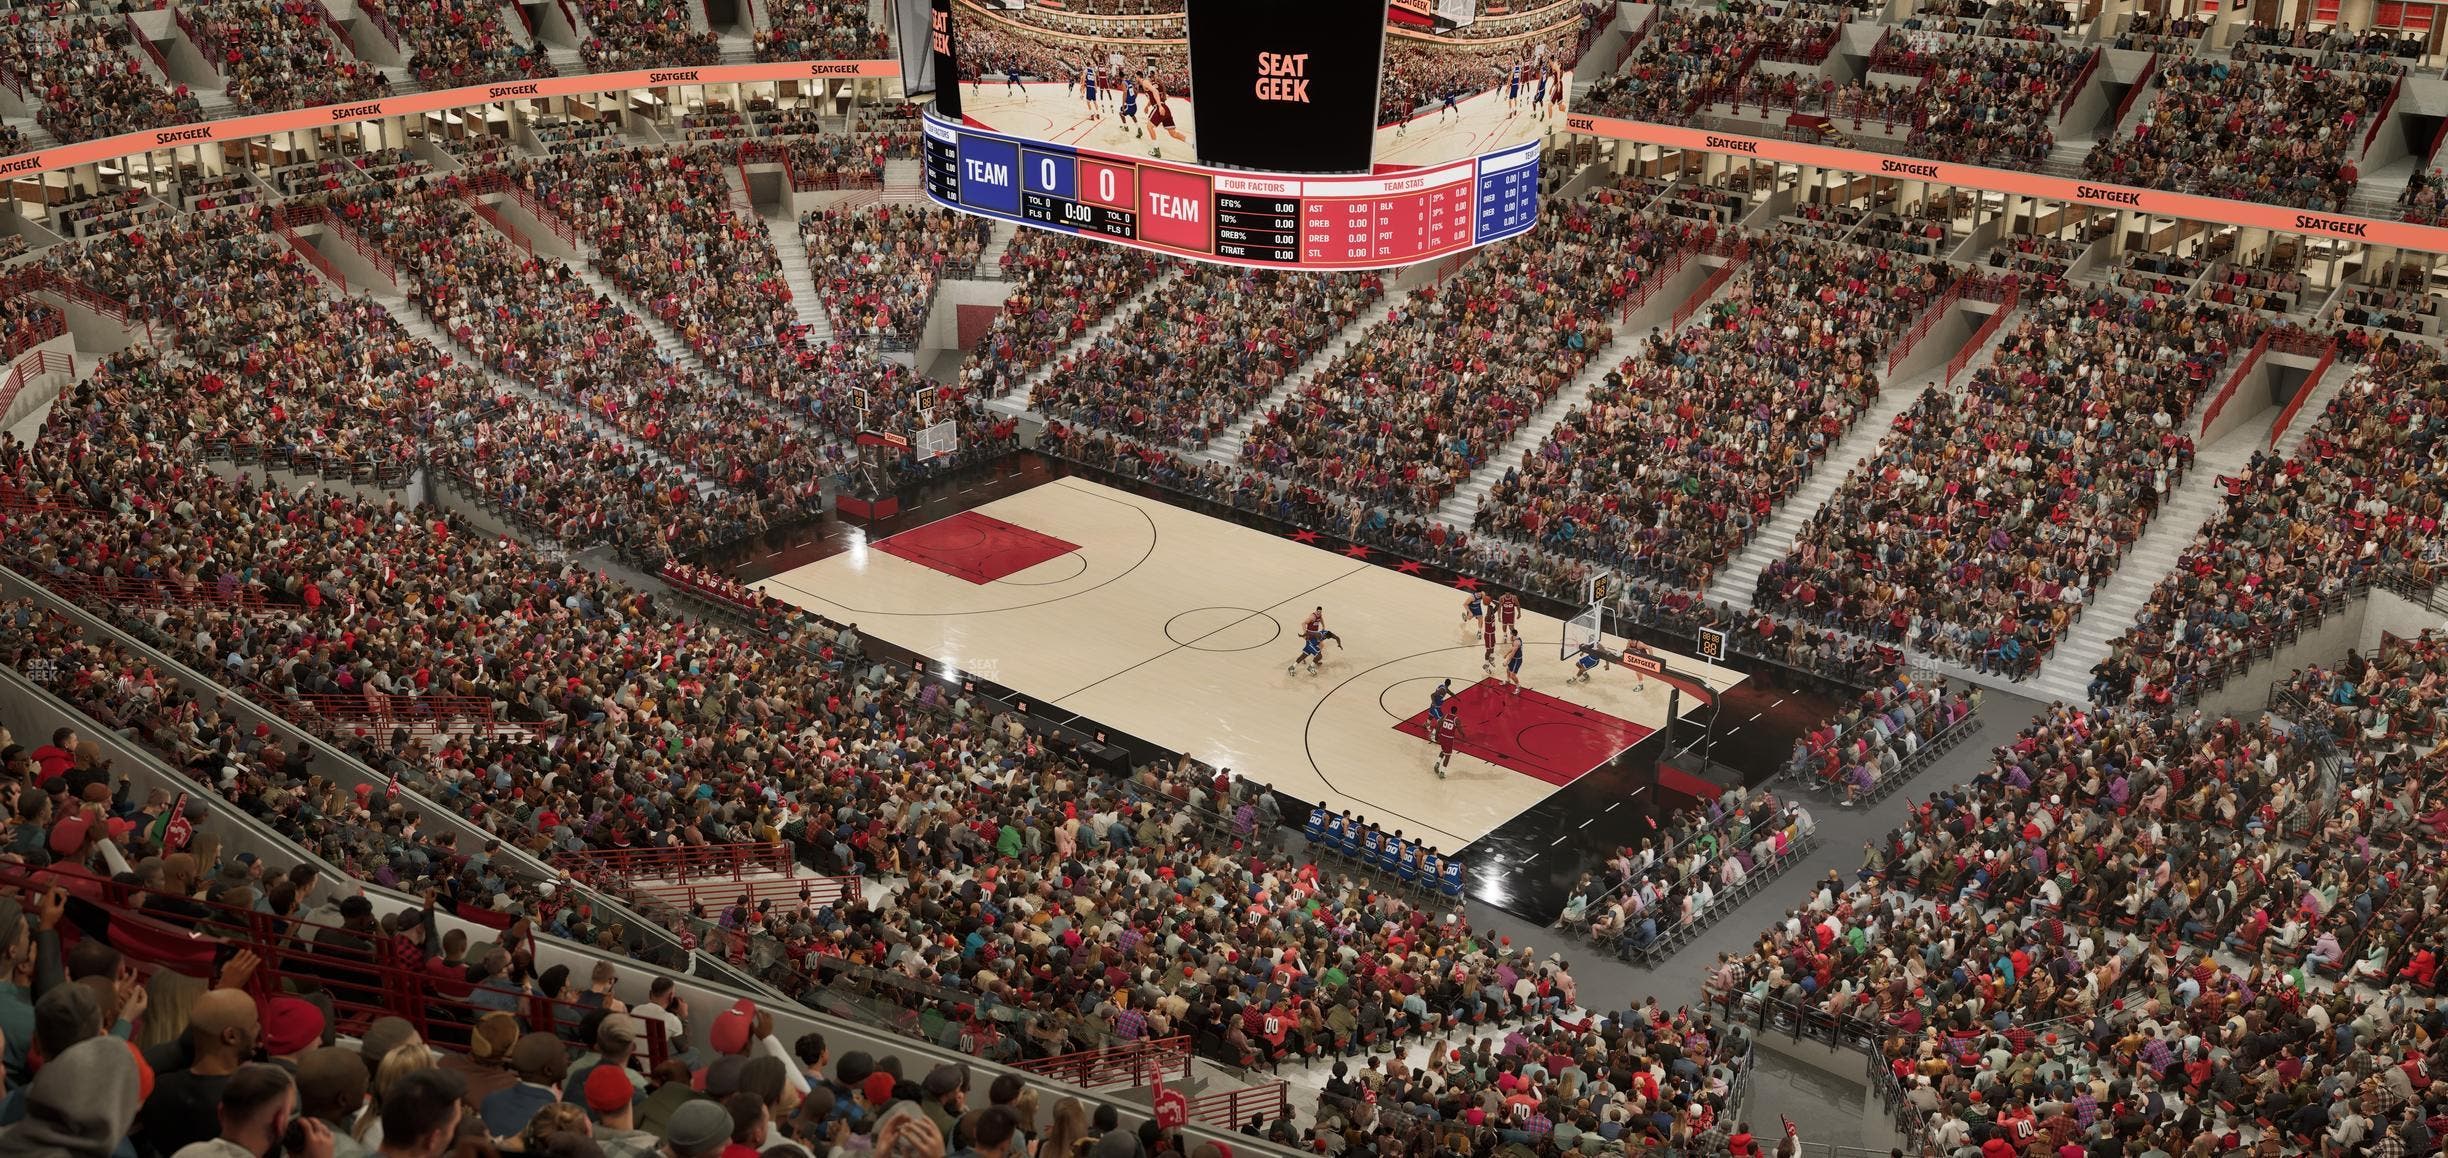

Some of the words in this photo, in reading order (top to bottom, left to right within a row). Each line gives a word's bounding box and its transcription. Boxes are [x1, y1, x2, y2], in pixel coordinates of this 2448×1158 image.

[811, 63, 860, 75] SEATGEEK
[1258, 51, 1309, 77] SEAT
[650, 70, 699, 83] SEATGEEK
[489, 83, 538, 98] SEATGEEK
[1255, 77, 1310, 103] GEEK
[332, 103, 382, 120] SEATGEEK
[156, 126, 212, 145] SEATGEEK
[1706, 136, 1757, 153] SEATGEEK
[0, 156, 42, 174] ATGEEK
[1882, 159, 1938, 178] SEATGEEK
[965, 158, 1008, 187] TEAM
[1041, 158, 1056, 191] 0
[1099, 168, 1115, 202] 0
[1224, 179, 1246, 190] FOUR
[1248, 182, 1285, 193] FACTORS
[1383, 181, 1404, 191] TEAM
[1405, 178, 1424, 189] STATS
[1484, 180, 1492, 189] AST
[1028, 196, 1043, 206] TOL
[1045, 198, 1050, 207] 0
[2077, 185, 2140, 206] SEATGEEK
[1065, 203, 1091, 222] 0:00
[1149, 192, 1199, 223] TEAM
[1220, 199, 1242, 209] EFG%
[1275, 203, 1294, 212] 0.00
[1308, 204, 1323, 213] AST
[1349, 204, 1367, 213] 0.00
[1380, 202, 1394, 211] BLK
[1029, 209, 1042, 218] FLS
[1046, 211, 1051, 221] 0
[1106, 211, 1122, 221] TOL
[1124, 213, 1130, 223] 0
[1107, 224, 1121, 233] FLS
[1125, 227, 1130, 236] 0
[1275, 219, 1294, 228] 0.00
[1349, 219, 1367, 228] 0.00
[2296, 215, 2367, 237] SEATGEEK
[1220, 230, 1246, 240] OREB%
[1275, 235, 1294, 244] 0.00
[1308, 234, 1330, 242] DREB
[1348, 234, 1367, 243] 0.00
[1379, 232, 1393, 240] POT
[1220, 245, 1245, 256] FTRATE
[1274, 250, 1294, 260] 0.00
[1308, 249, 1322, 257] STL
[1348, 248, 1367, 258] 0.00
[1379, 247, 1391, 255] STL
[1703, 641, 1717, 656] 88
[1627, 655, 1657, 670] SEATGEEK
[1443, 721, 1453, 730] 00
[1309, 816, 1321, 826] 00
[1365, 840, 1376, 849] 00
[1385, 844, 1398, 854] 00
[1423, 864, 1435, 874] 00
[1446, 866, 1457, 876] 00
[1250, 911, 1261, 925] 00
[1264, 1017, 1279, 1034] 00
[960, 1034, 973, 1052] 00
[1513, 1102, 1531, 1120] 00
[2017, 1119, 2034, 1138] 00
